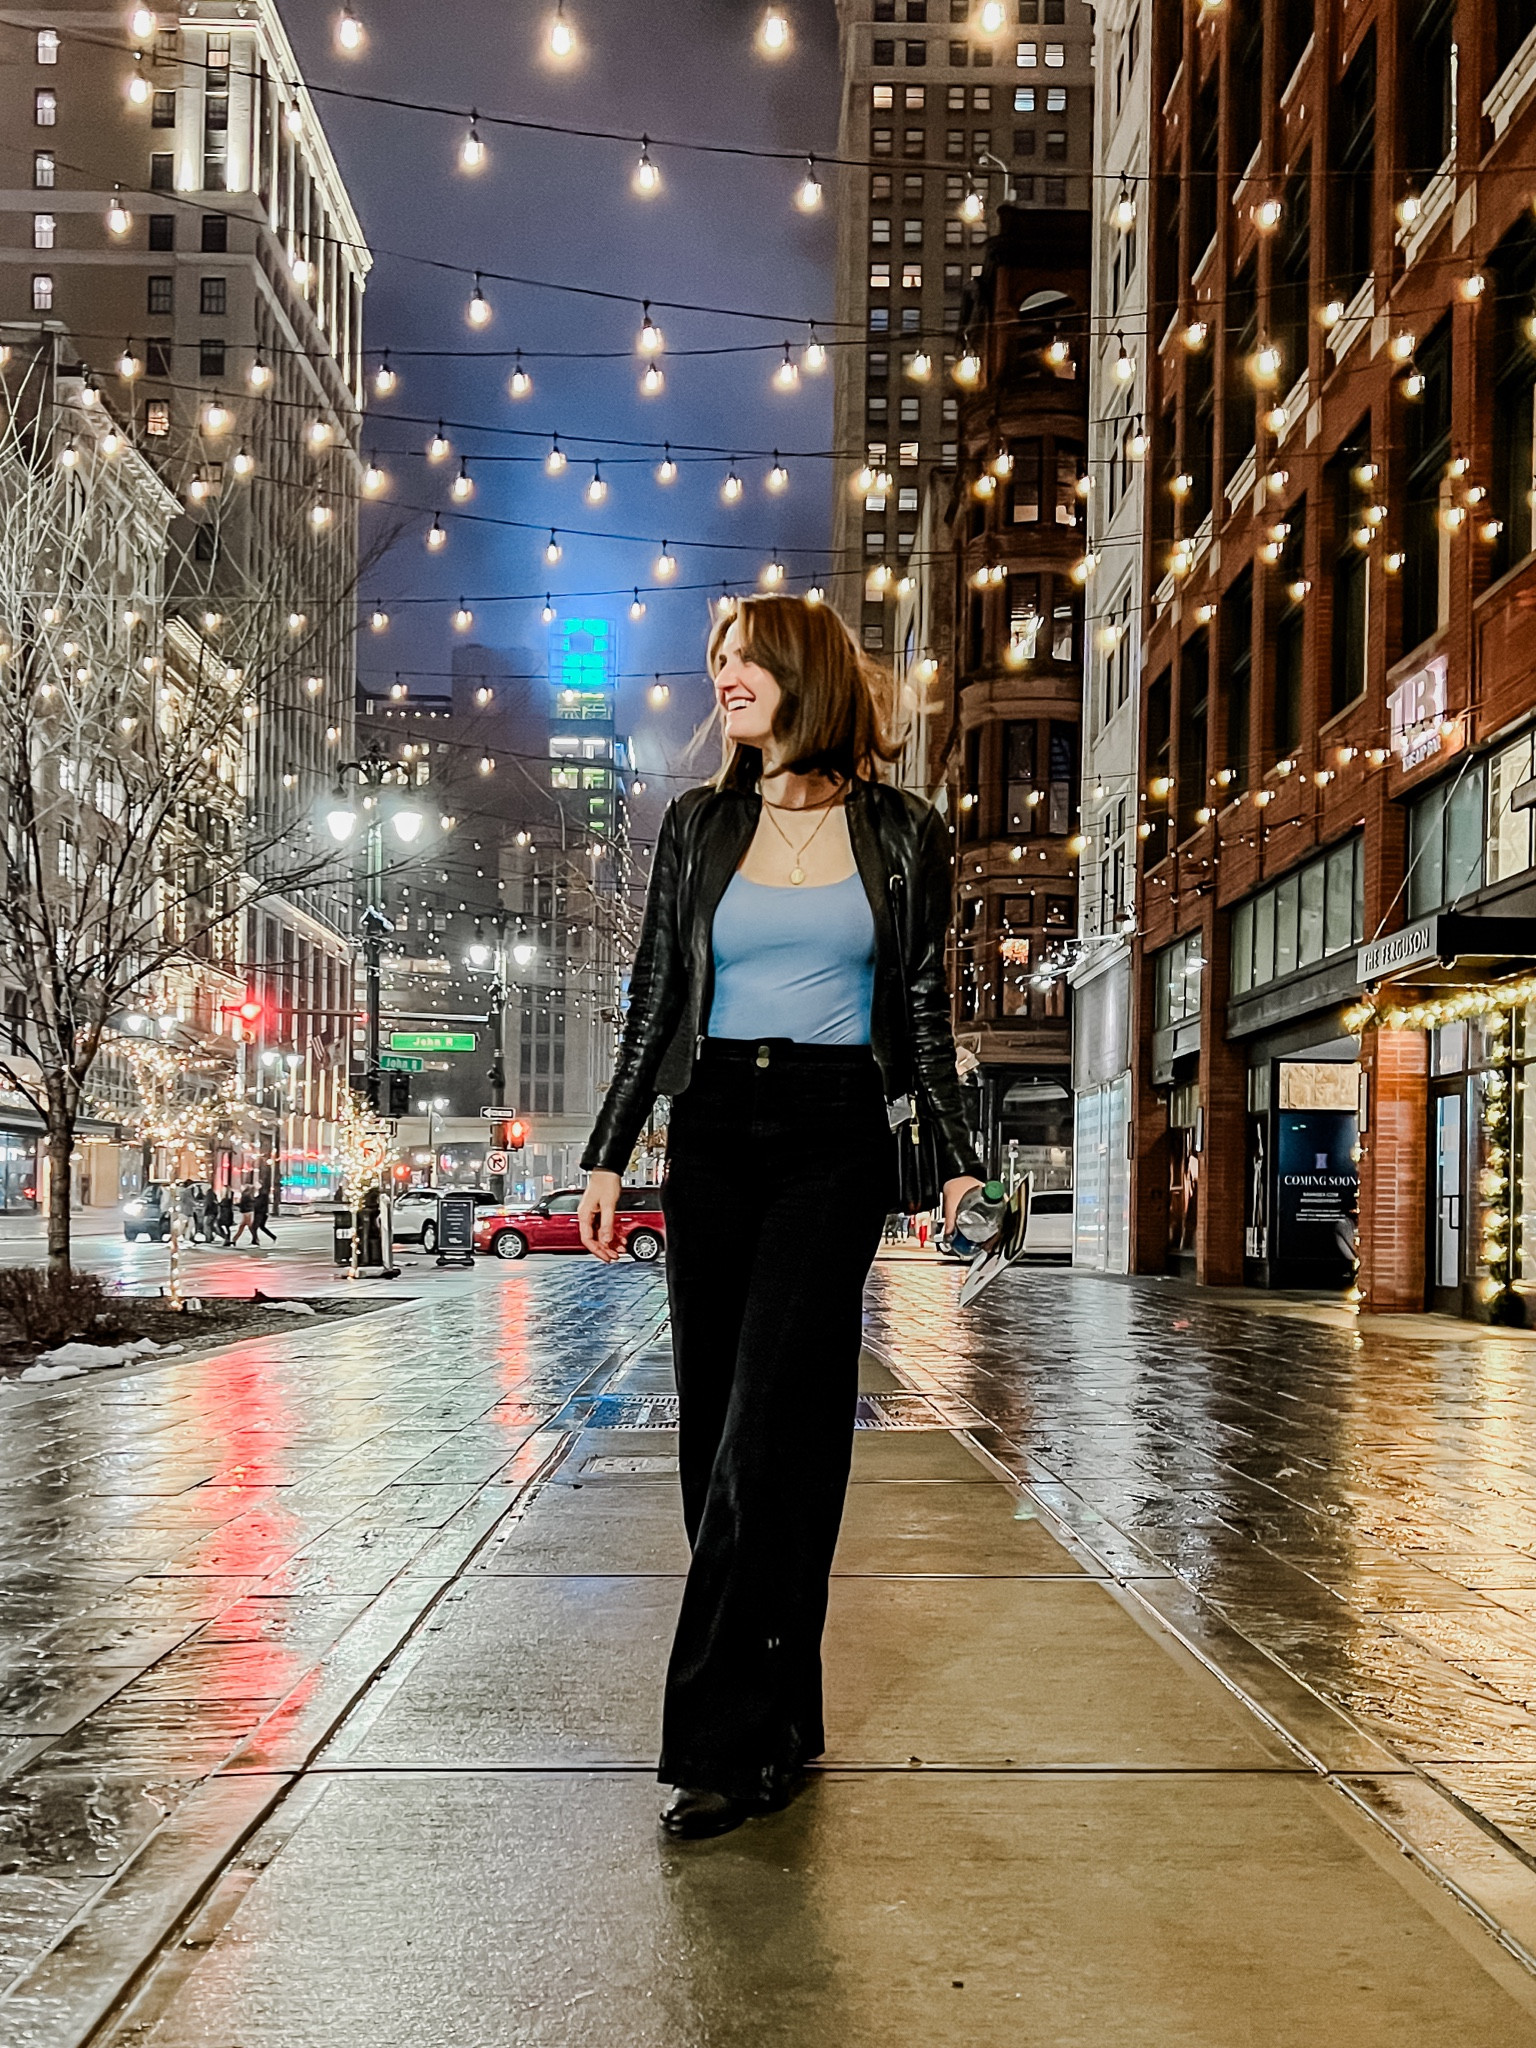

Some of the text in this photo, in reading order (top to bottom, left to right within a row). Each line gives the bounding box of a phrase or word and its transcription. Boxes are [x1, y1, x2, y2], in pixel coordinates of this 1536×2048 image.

[1364, 928, 1429, 972] THE FERGUSON
[413, 1037, 441, 1046] John
[386, 1058, 408, 1069] John
[1285, 1175, 1357, 1187] COMING SOON
